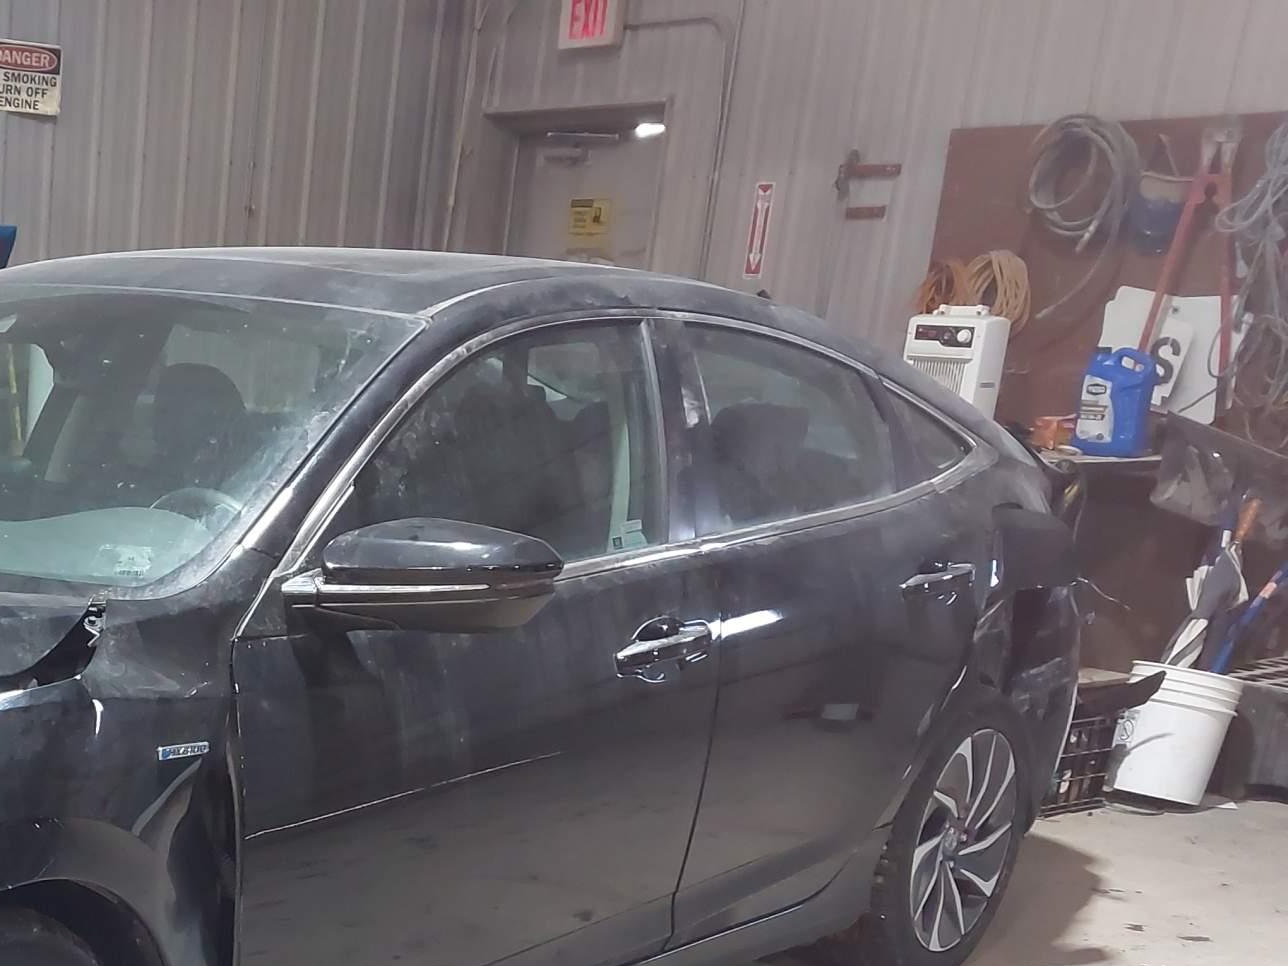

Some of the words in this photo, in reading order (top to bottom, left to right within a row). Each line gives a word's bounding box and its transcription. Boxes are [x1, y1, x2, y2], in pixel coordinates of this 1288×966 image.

[568, 0, 609, 40] EXIT
[3, 71, 57, 88] SMOKING
[26, 86, 49, 99] OFF
